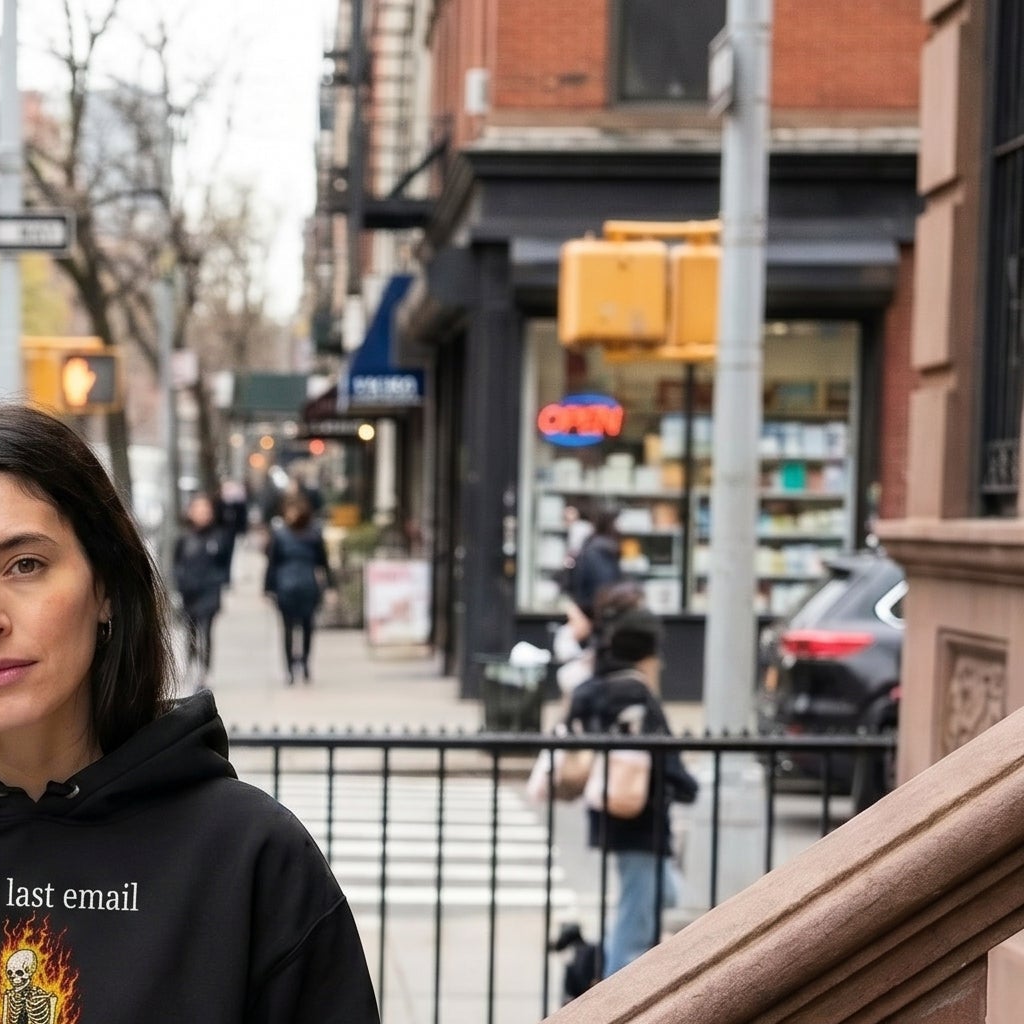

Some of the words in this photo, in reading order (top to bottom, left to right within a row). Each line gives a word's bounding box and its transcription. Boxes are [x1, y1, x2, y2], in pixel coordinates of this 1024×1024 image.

[538, 404, 623, 436] OPEN
[5, 877, 55, 908] last
[63, 882, 139, 912] email
